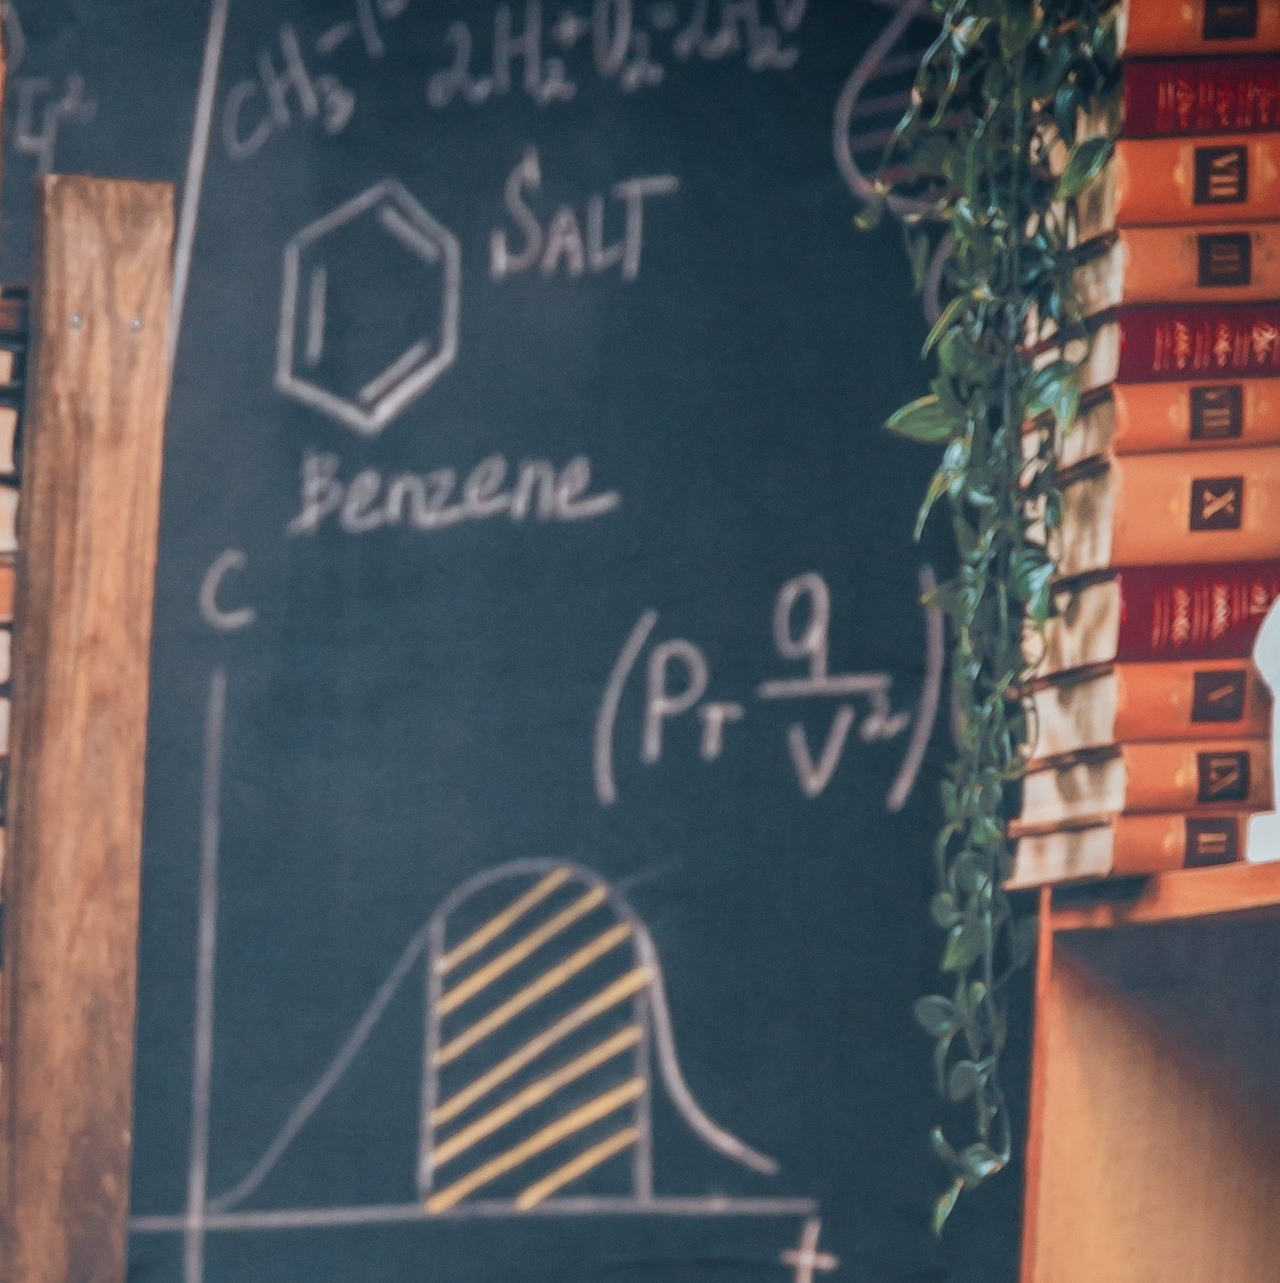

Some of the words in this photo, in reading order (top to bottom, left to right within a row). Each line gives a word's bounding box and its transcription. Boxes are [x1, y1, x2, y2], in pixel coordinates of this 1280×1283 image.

[491, 150, 679, 281] SALT
[289, 450, 620, 536] Benzene
[1201, 488, 1235, 521] X
[198, 550, 256, 633] C
